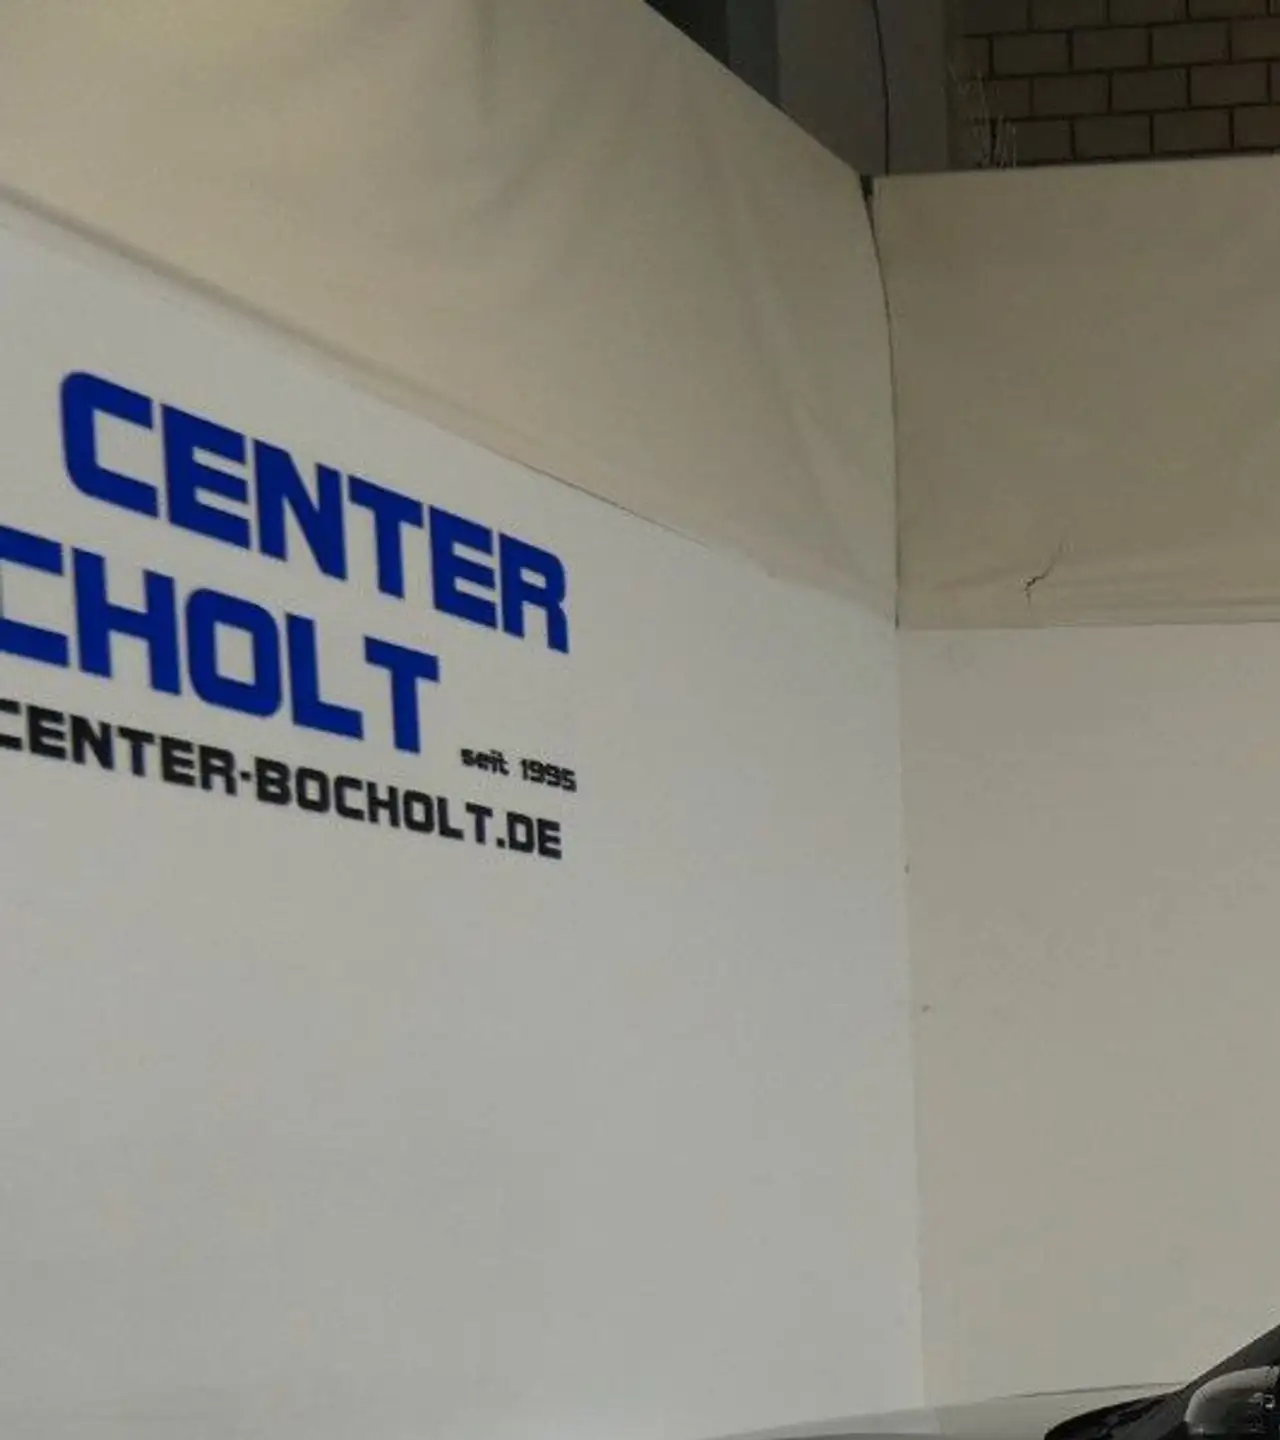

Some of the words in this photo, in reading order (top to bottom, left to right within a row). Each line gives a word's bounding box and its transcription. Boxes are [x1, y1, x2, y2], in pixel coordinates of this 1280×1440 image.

[61, 371, 570, 654] CENTER
[459, 747, 510, 777] seit
[519, 757, 578, 793] 1995
